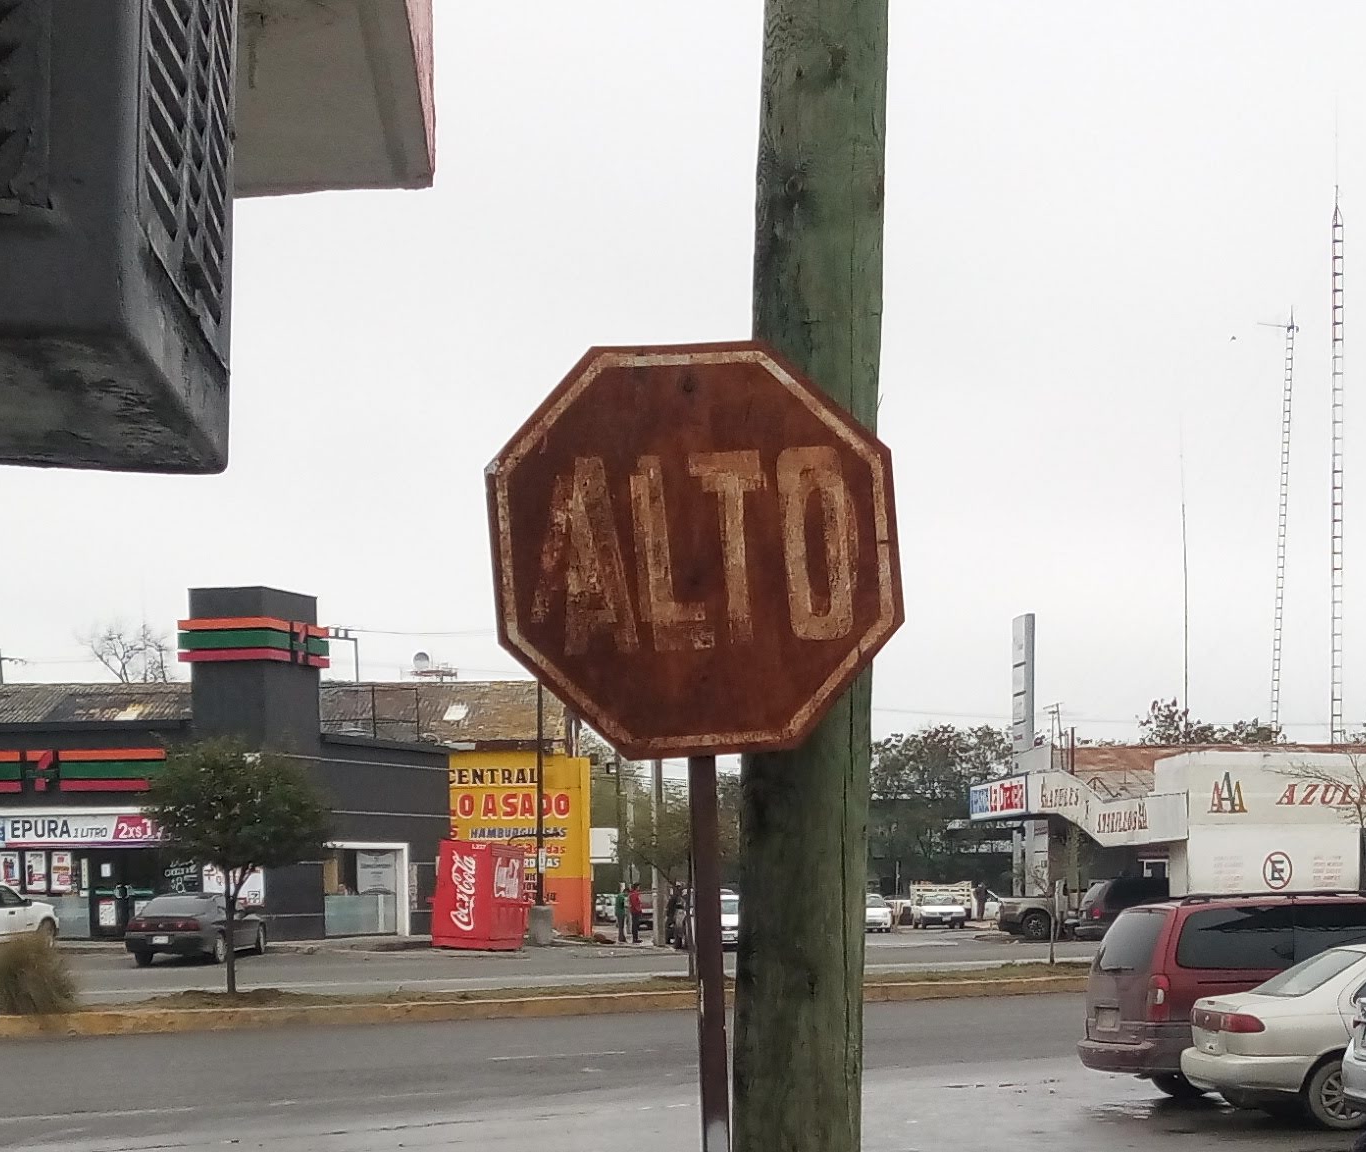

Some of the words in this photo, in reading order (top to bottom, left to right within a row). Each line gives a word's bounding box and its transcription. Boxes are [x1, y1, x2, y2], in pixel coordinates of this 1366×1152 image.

[531, 446, 860, 655] ALTO
[448, 768, 539, 785] CENTRAL
[481, 792, 571, 819] ASADO
[10, 819, 72, 839] EPURA
[79, 827, 108, 839] LITRO
[469, 827, 567, 840] HAMBURGUSAS
[1268, 860, 1285, 881] E
[450, 850, 476, 932] Coca-Cola
